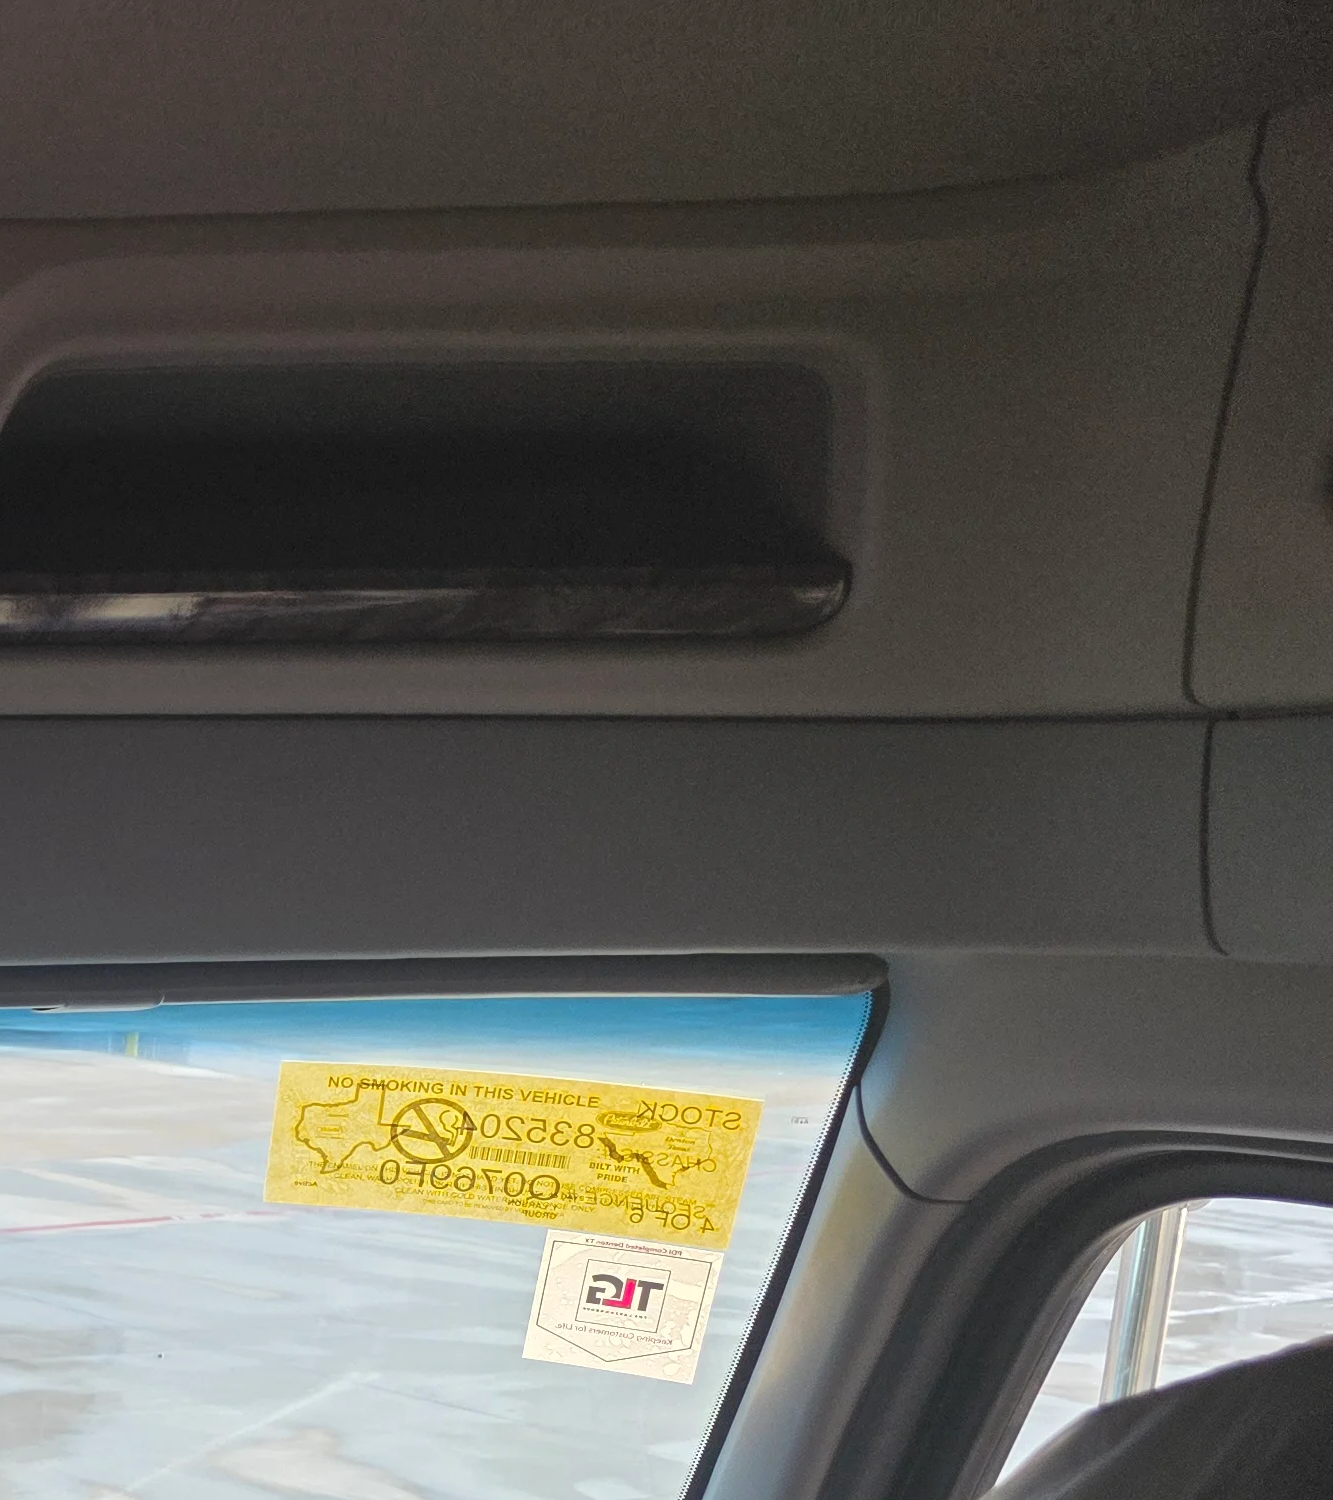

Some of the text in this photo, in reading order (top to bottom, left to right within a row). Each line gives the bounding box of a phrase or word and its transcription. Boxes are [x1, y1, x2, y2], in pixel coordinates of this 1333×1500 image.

[328, 1076, 601, 1109] NO SMOKING IN THIS VEHICLE
[589, 1161, 641, 1175] BILT WITH
[596, 1172, 628, 1184] PRIDE
